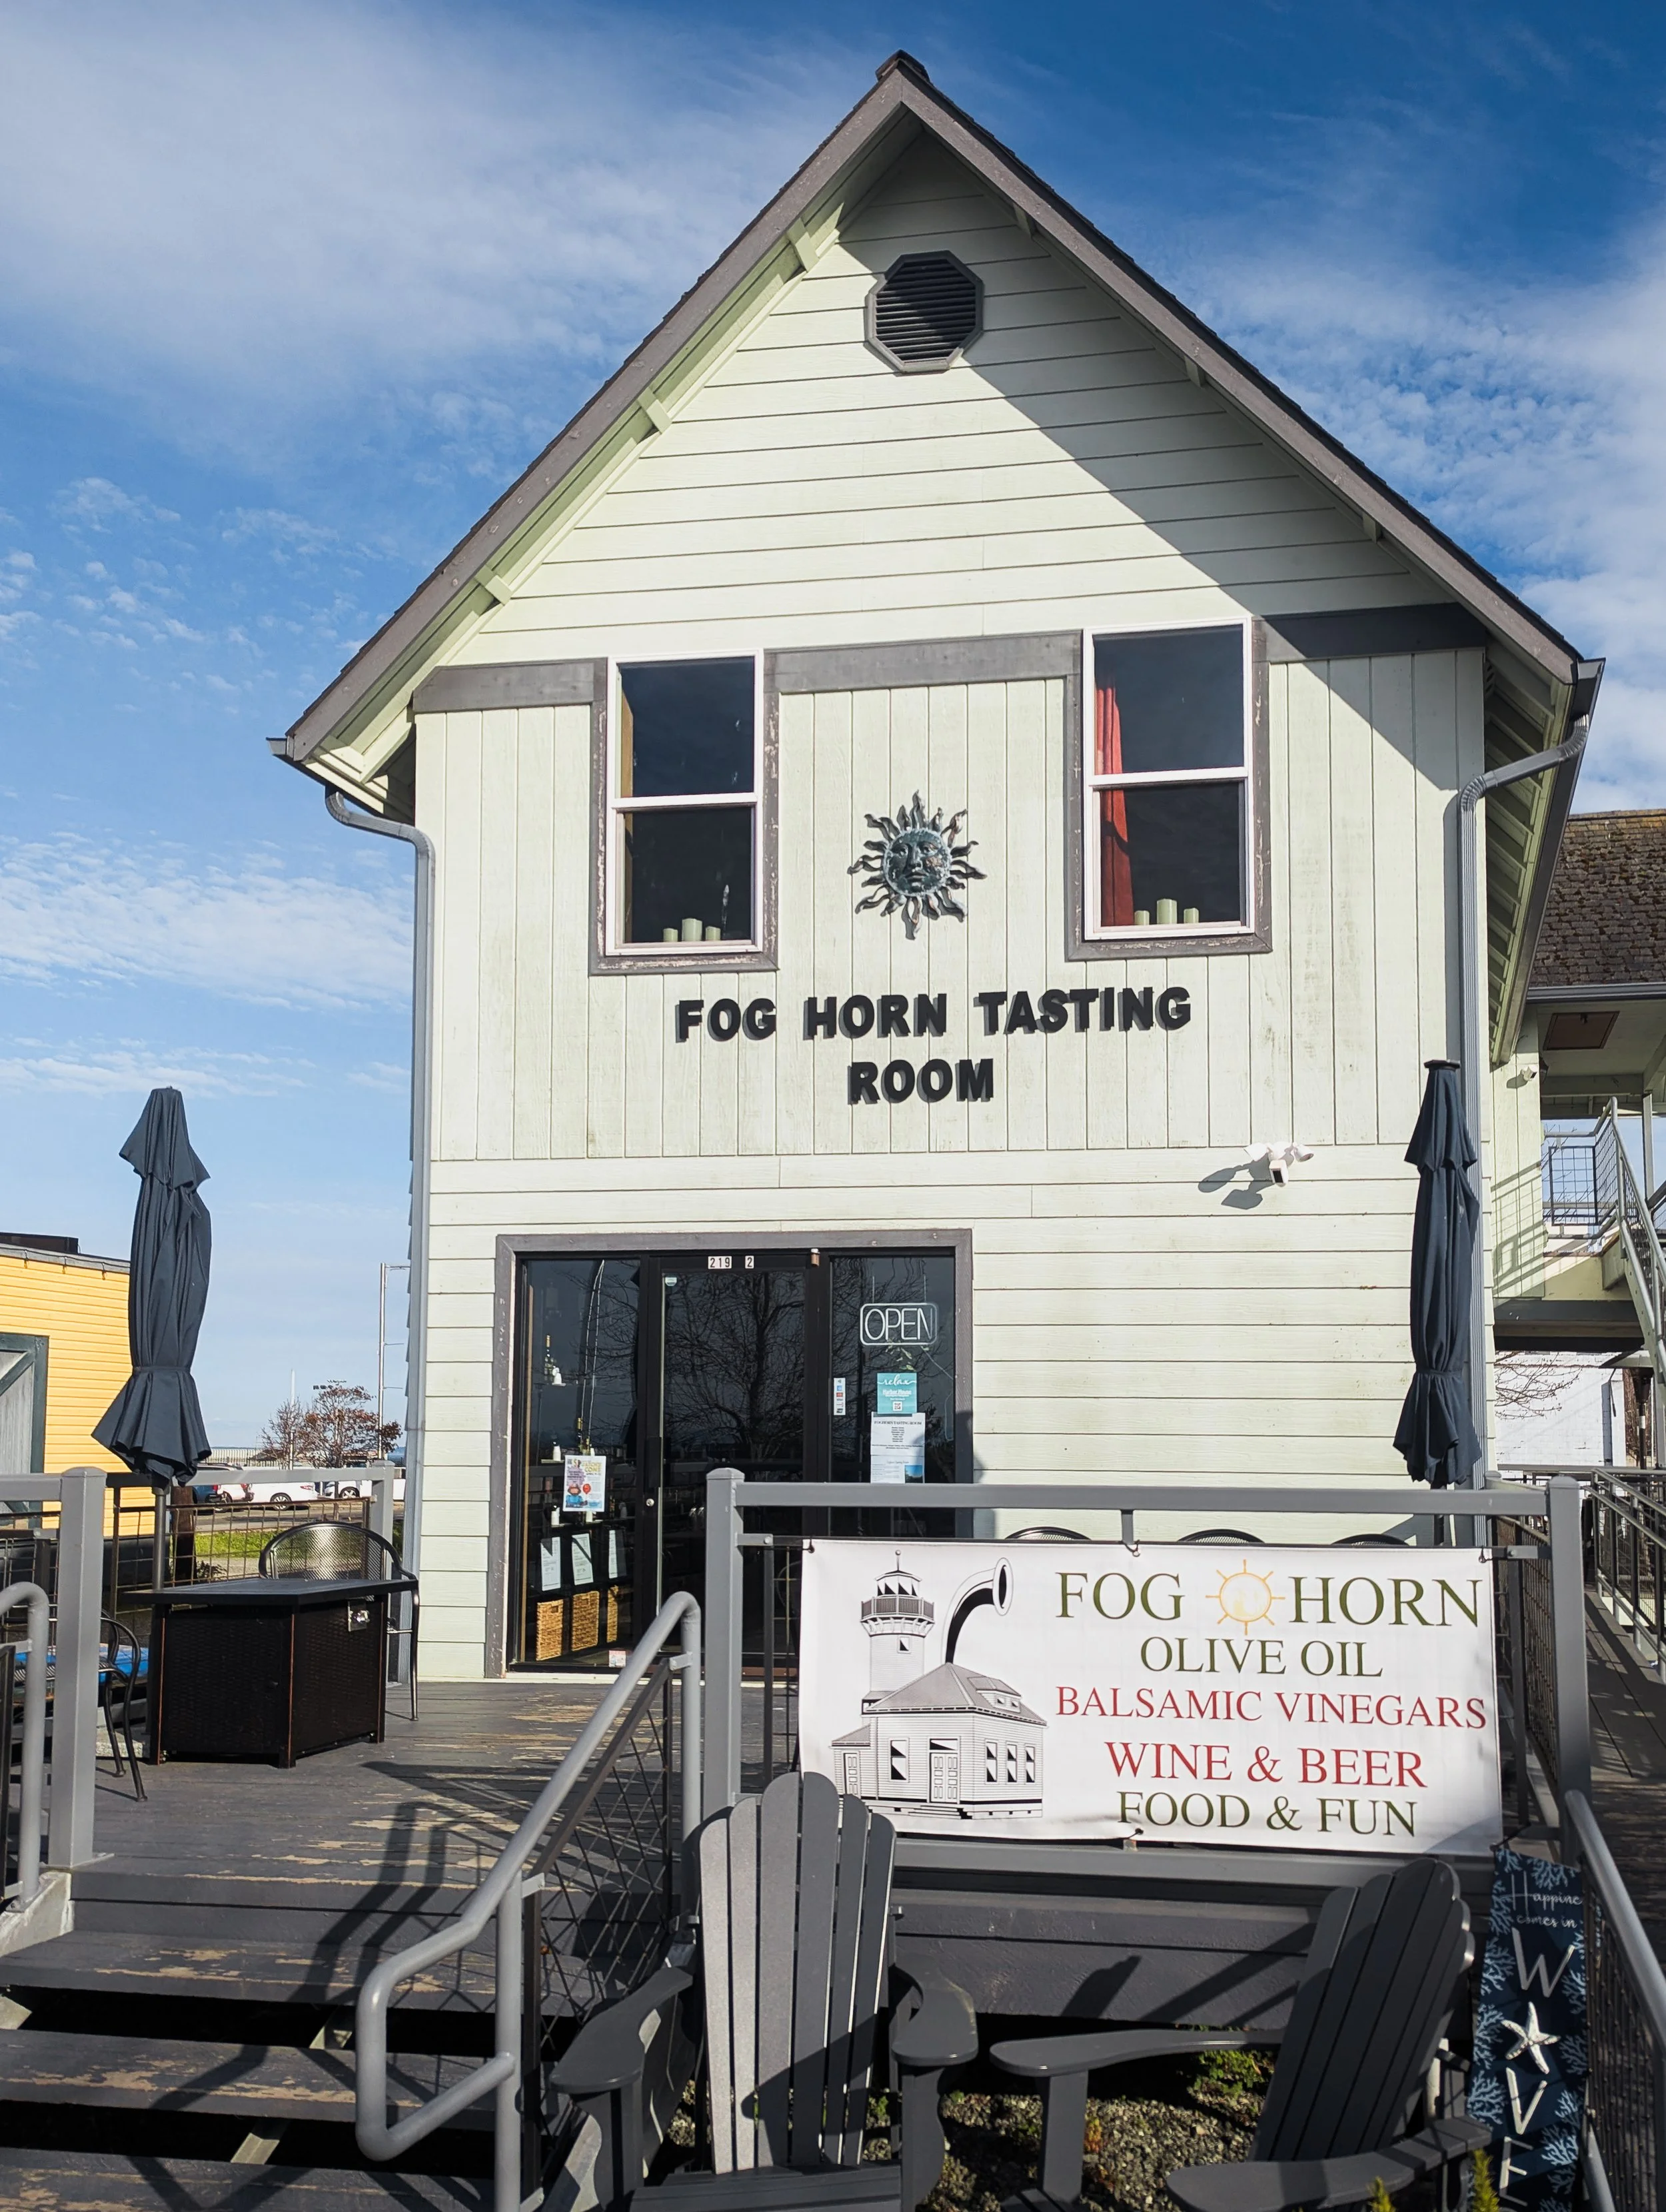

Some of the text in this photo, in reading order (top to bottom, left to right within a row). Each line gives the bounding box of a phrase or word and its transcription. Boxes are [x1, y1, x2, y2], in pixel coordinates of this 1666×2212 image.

[679, 987, 1191, 1041] FOG HORN TASTING
[850, 1058, 993, 1104] ROOM
[710, 1257, 752, 1268] 219 2
[864, 1308, 933, 1341] OPEN
[877, 1373, 916, 1385] relax
[1056, 1572, 1483, 1628] FOG HORN
[1141, 1636, 1383, 1677] OLIVE OIL
[1056, 1686, 1486, 1729] BALSAMIC VINEGARS
[1104, 1742, 1427, 1788] WINE & BEER
[1118, 1791, 1416, 1838] FOOD & FUN
[1502, 1870, 1582, 1914] Happine
[1517, 1916, 1577, 1929] comes in
